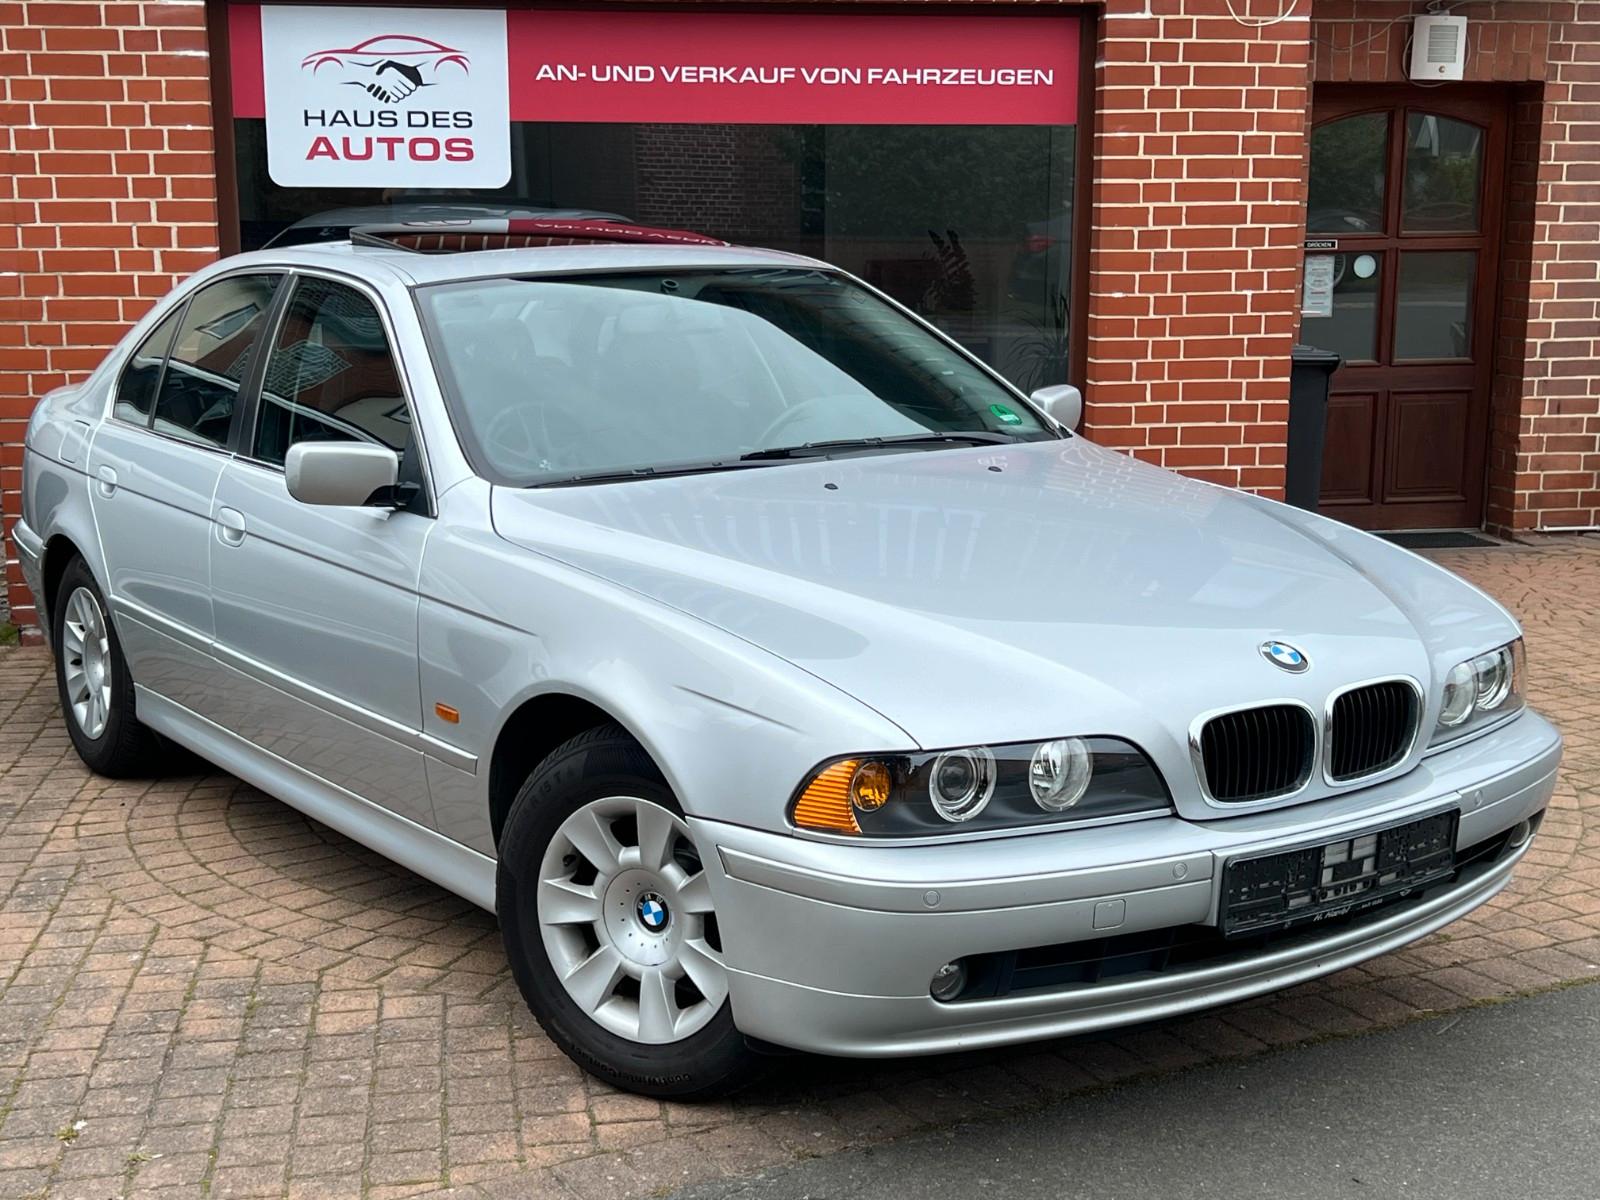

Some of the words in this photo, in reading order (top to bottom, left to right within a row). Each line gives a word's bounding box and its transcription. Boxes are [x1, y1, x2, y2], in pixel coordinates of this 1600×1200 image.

[535, 64, 586, 81] AN-
[591, 65, 654, 82] UND
[660, 66, 796, 84] VERKAUF
[800, 67, 861, 84] VON
[867, 68, 1054, 85] FAHRZEUGEN
[303, 109, 399, 128] HAUS
[407, 110, 474, 129] DES
[305, 136, 474, 162] AUTOS
